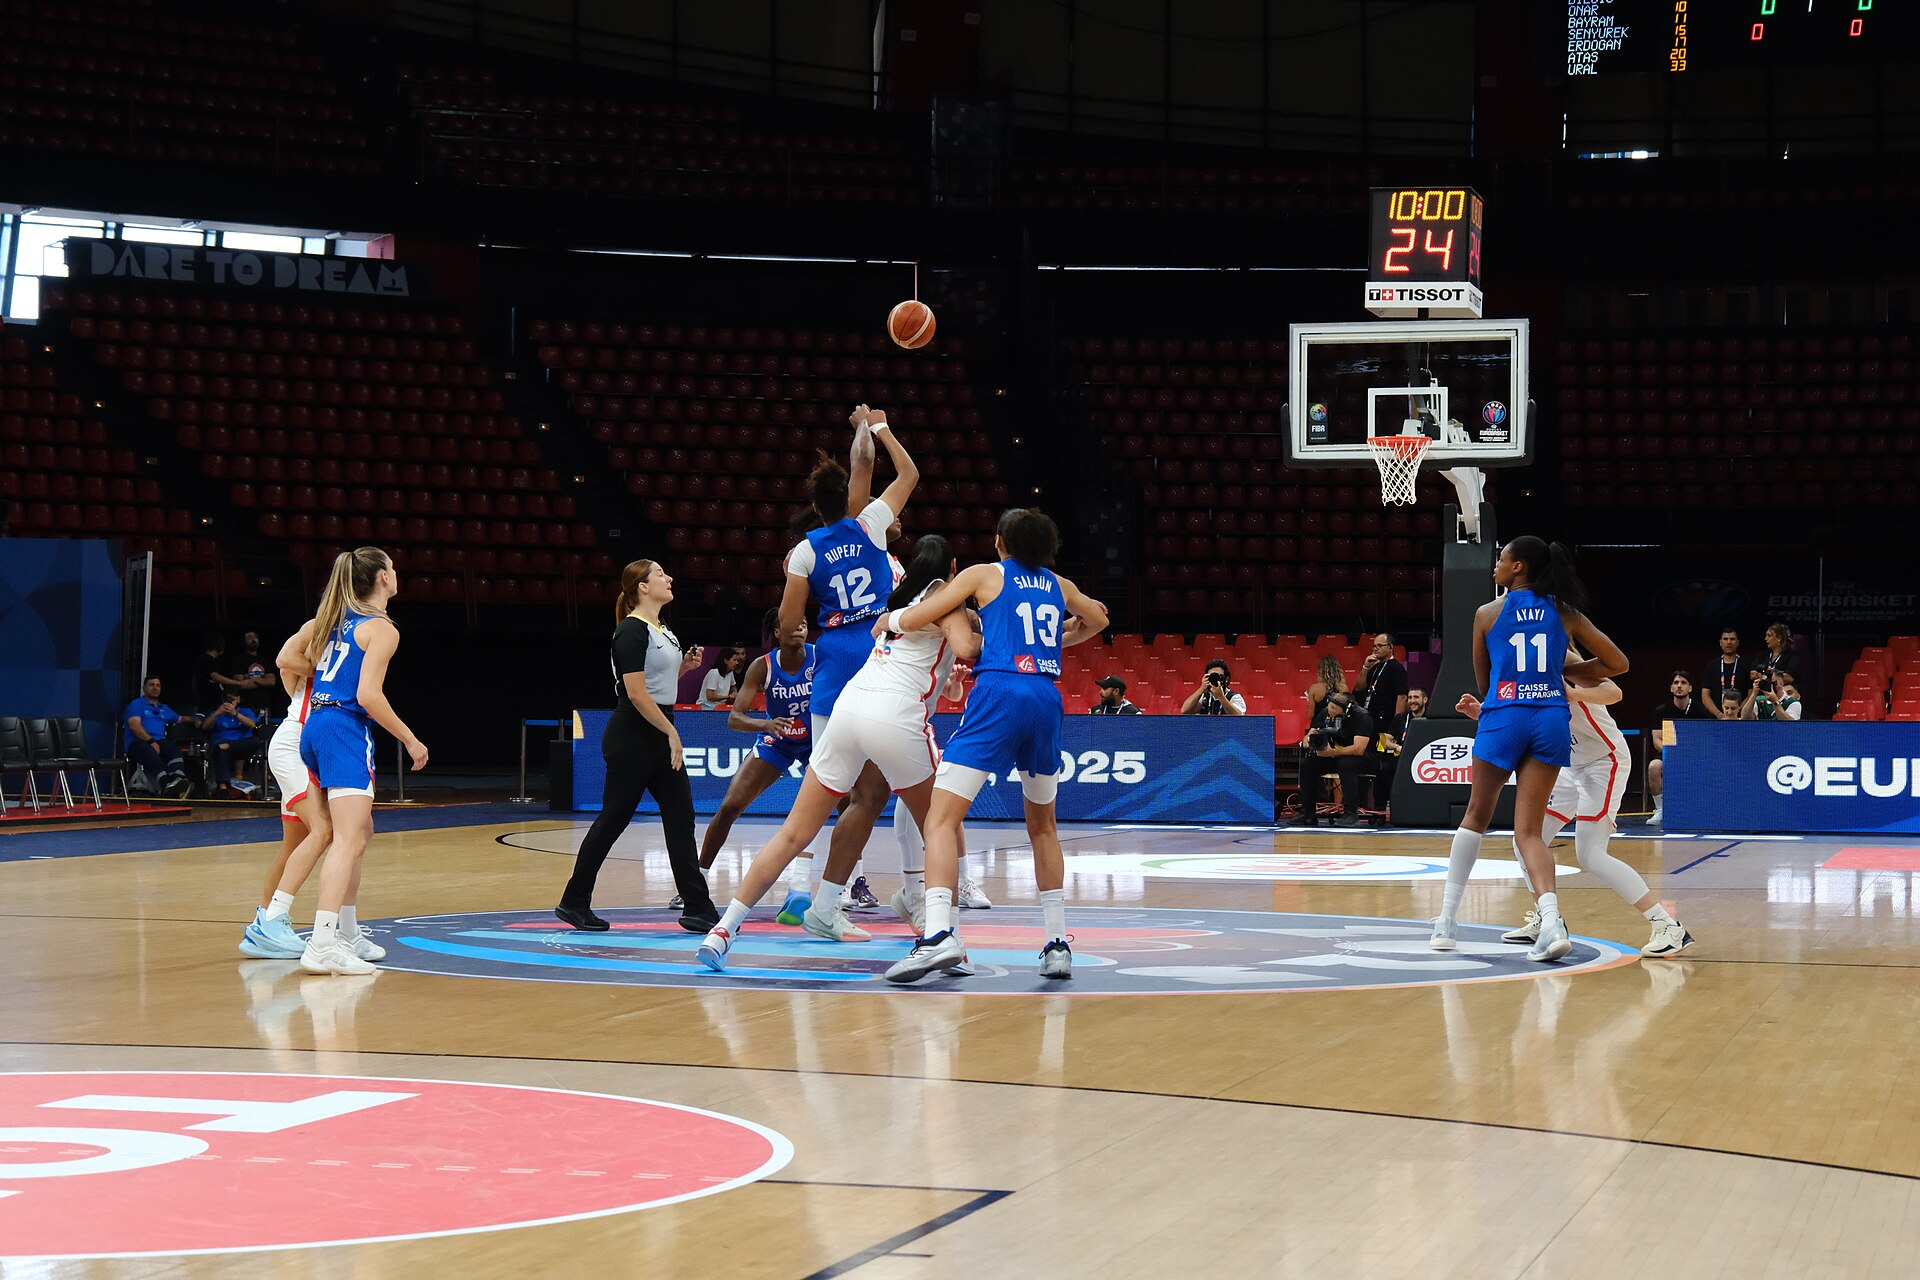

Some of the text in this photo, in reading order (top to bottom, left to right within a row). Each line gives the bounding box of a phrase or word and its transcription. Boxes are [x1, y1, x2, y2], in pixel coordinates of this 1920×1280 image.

[1568, 1, 1687, 16] ONAR 10
[1568, 13, 1687, 28] BAYRAM 11
[1850, 19, 1862, 36] 0
[1568, 25, 1686, 39] SENYUREK 15
[1751, 24, 1763, 40] 0
[1568, 37, 1687, 52] ERDOGAN 17
[1568, 49, 1686, 63] ATAS 20
[1568, 60, 1686, 75] URAL 33
[1389, 191, 1465, 220] 10:00
[1384, 228, 1454, 271] 24
[91, 243, 410, 297] DARE TO DREAM
[1396, 289, 1465, 301] TISSOT
[824, 544, 863, 564] RUPERT
[829, 567, 876, 609] 12
[1013, 575, 1052, 593] SALAÜN
[1768, 594, 1917, 607] EUROBASKET
[1516, 609, 1545, 622] AYAYI
[1015, 602, 1060, 647] 13
[1509, 633, 1547, 672] 11
[772, 682, 813, 699] FRANC
[1518, 684, 1549, 692] CAISSE
[781, 726, 807, 735] MAIF
[1430, 744, 1468, 760] 百岁
[1417, 759, 1473, 782] Gant
[1766, 755, 1920, 798] @EU
